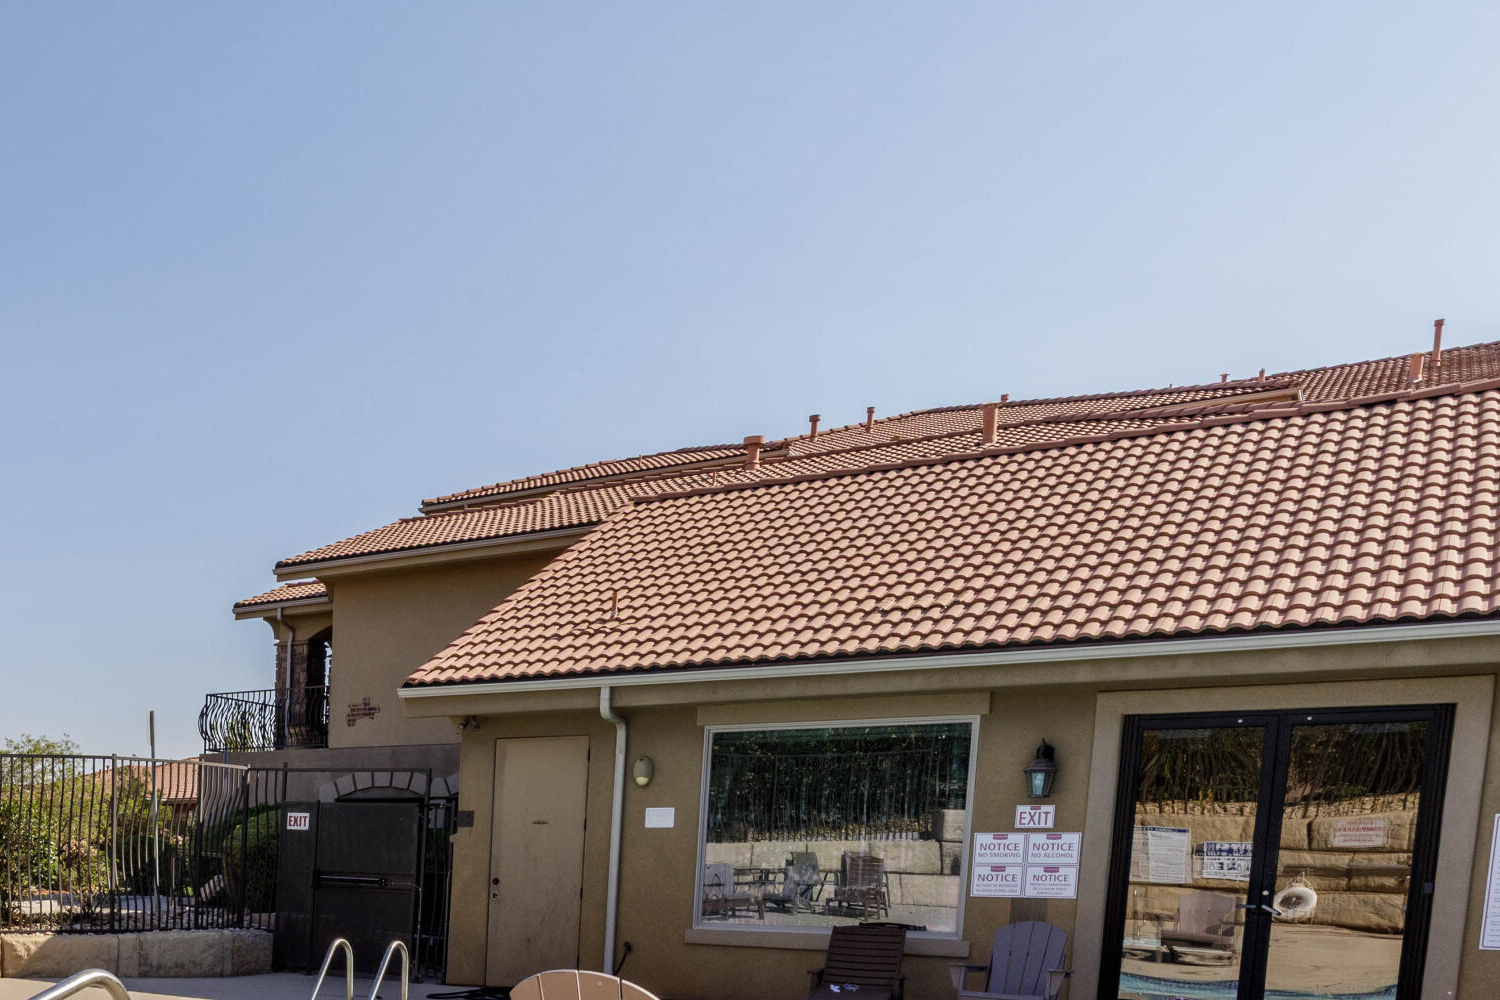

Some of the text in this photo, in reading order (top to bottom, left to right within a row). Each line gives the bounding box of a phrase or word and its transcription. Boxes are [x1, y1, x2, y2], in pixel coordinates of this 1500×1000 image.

[288, 815, 308, 828] EXIT
[1018, 811, 1051, 826] EXIT
[979, 842, 1020, 851] NOTICE
[1032, 842, 1074, 851] NOTICE
[977, 873, 1018, 883] NOTICE
[1032, 874, 1069, 882] NOTICE
